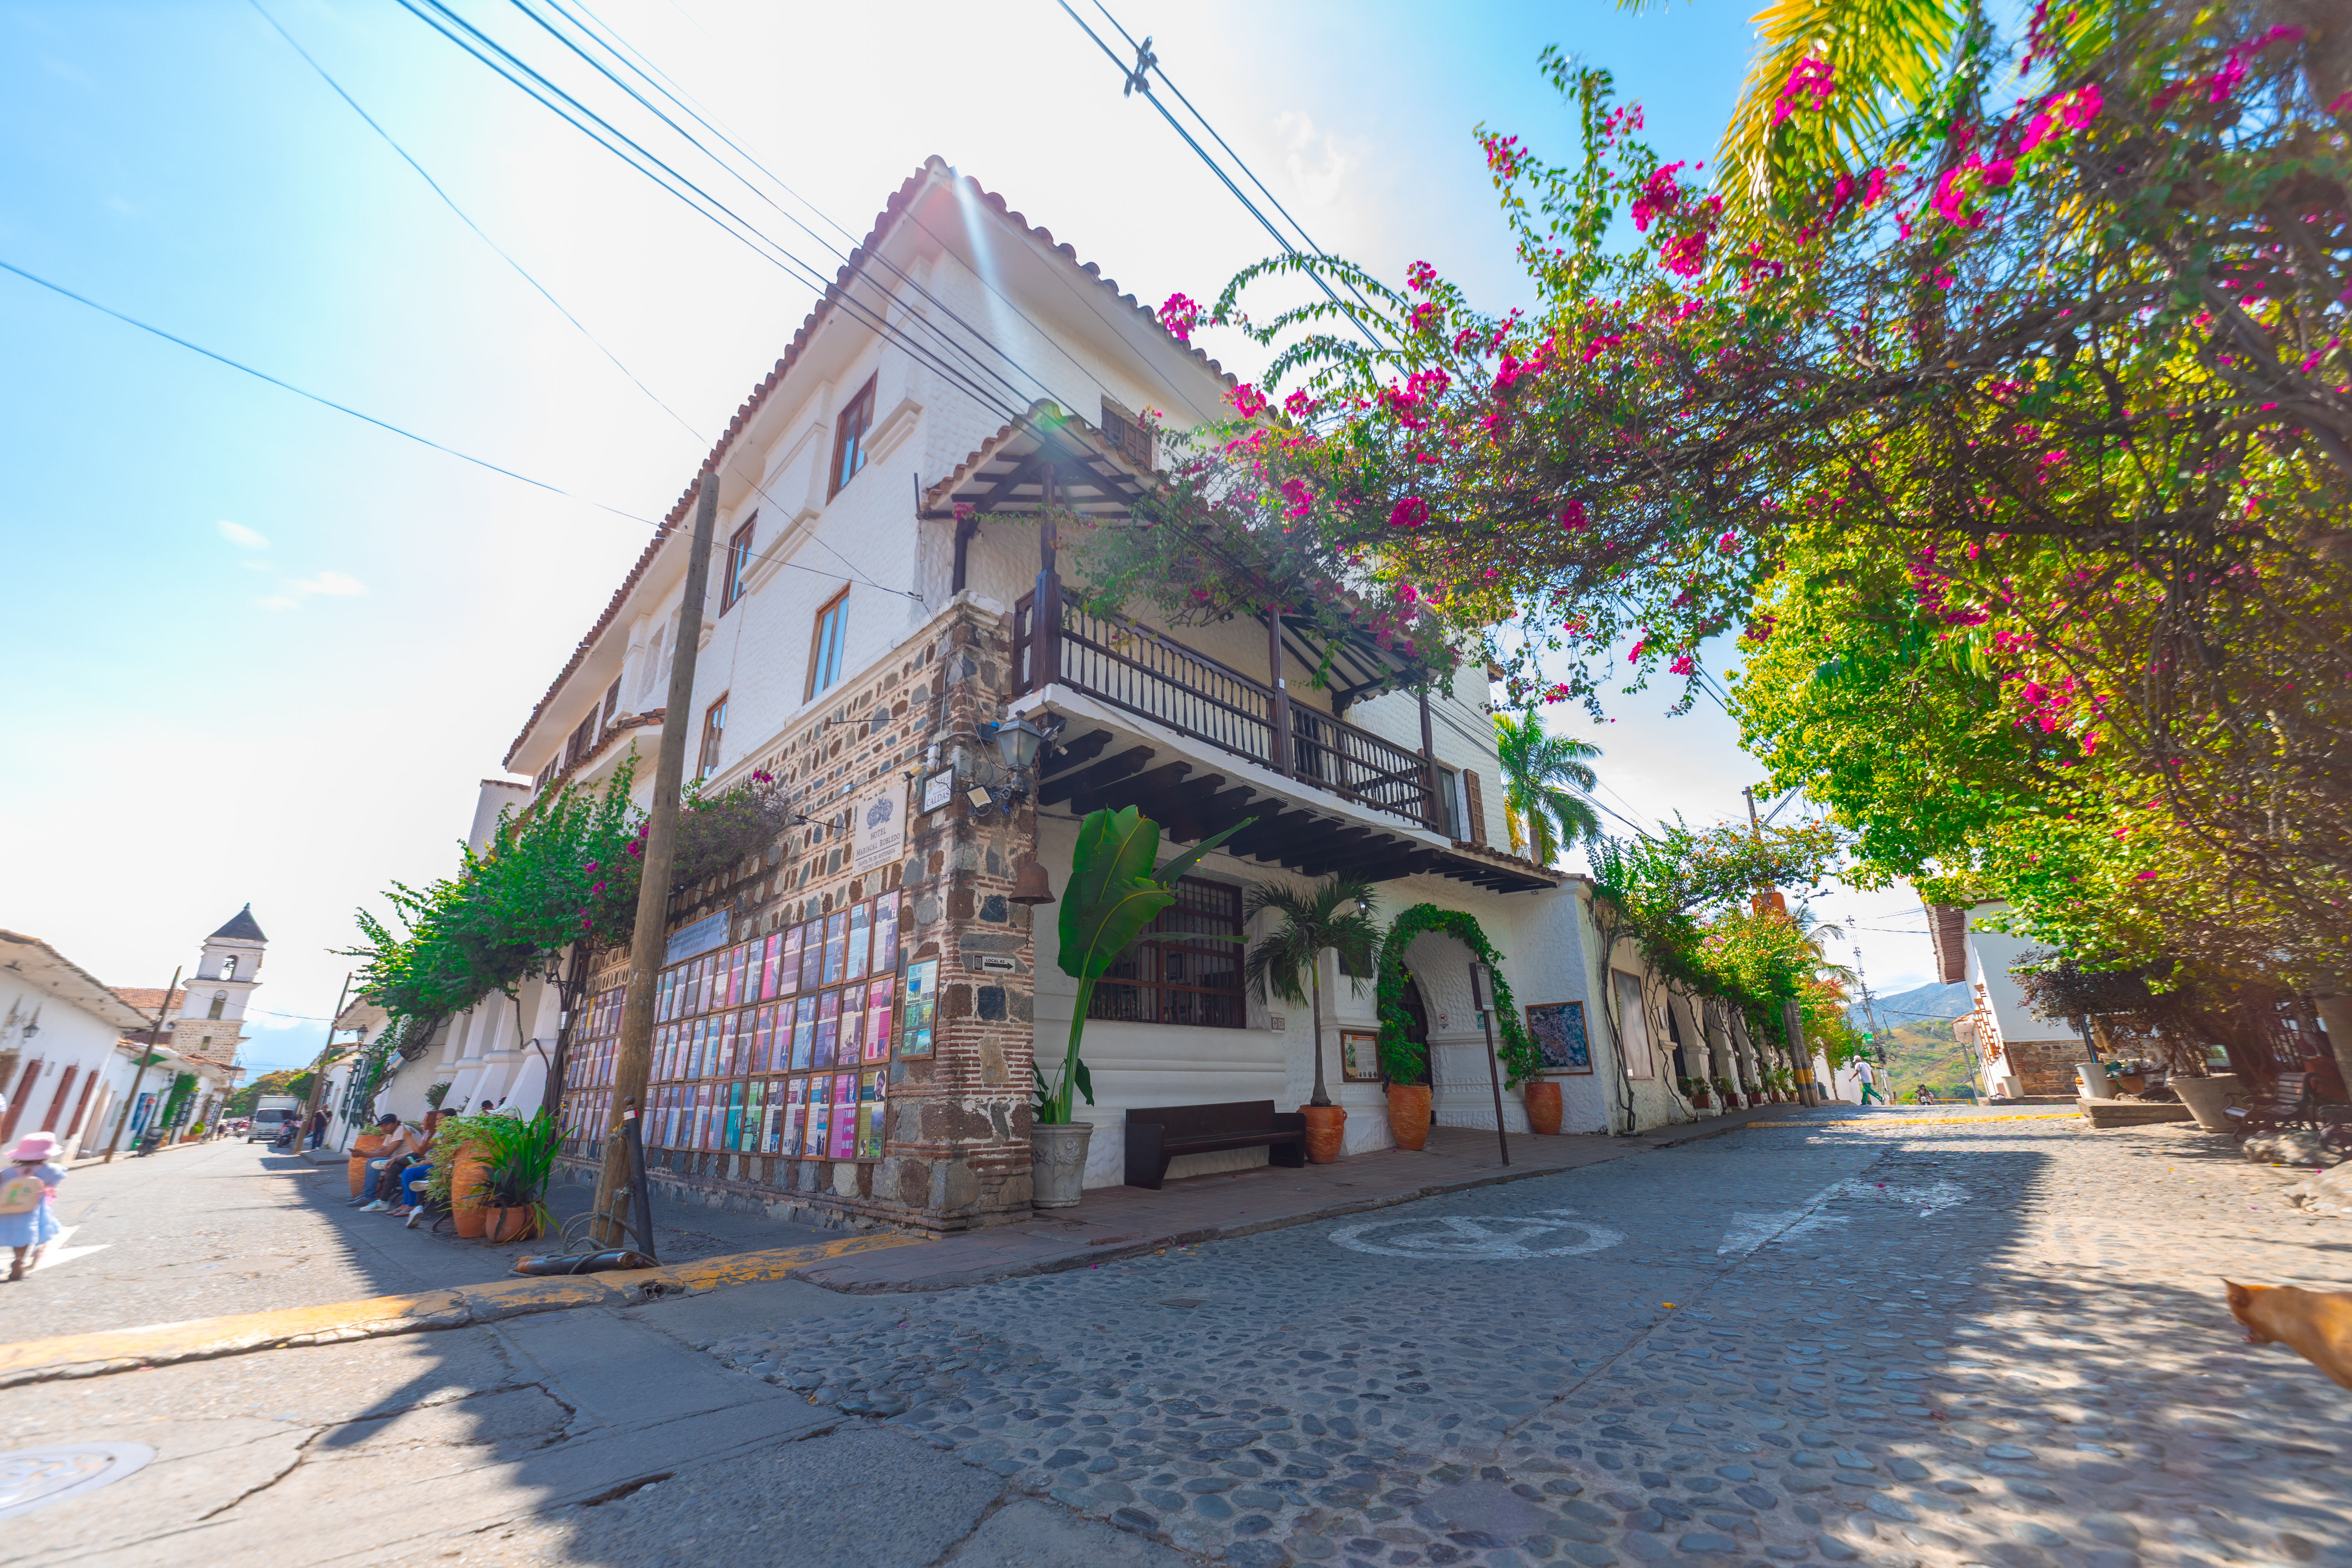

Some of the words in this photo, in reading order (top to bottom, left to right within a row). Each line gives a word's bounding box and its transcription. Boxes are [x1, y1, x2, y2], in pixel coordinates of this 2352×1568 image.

[926, 790, 949, 807] CALDAS
[870, 828, 886, 840] HOTEL
[856, 844, 878, 857] MARISCAL
[880, 833, 900, 847] ROBLEDO
[878, 848, 896, 858] ANTIOQUIA
